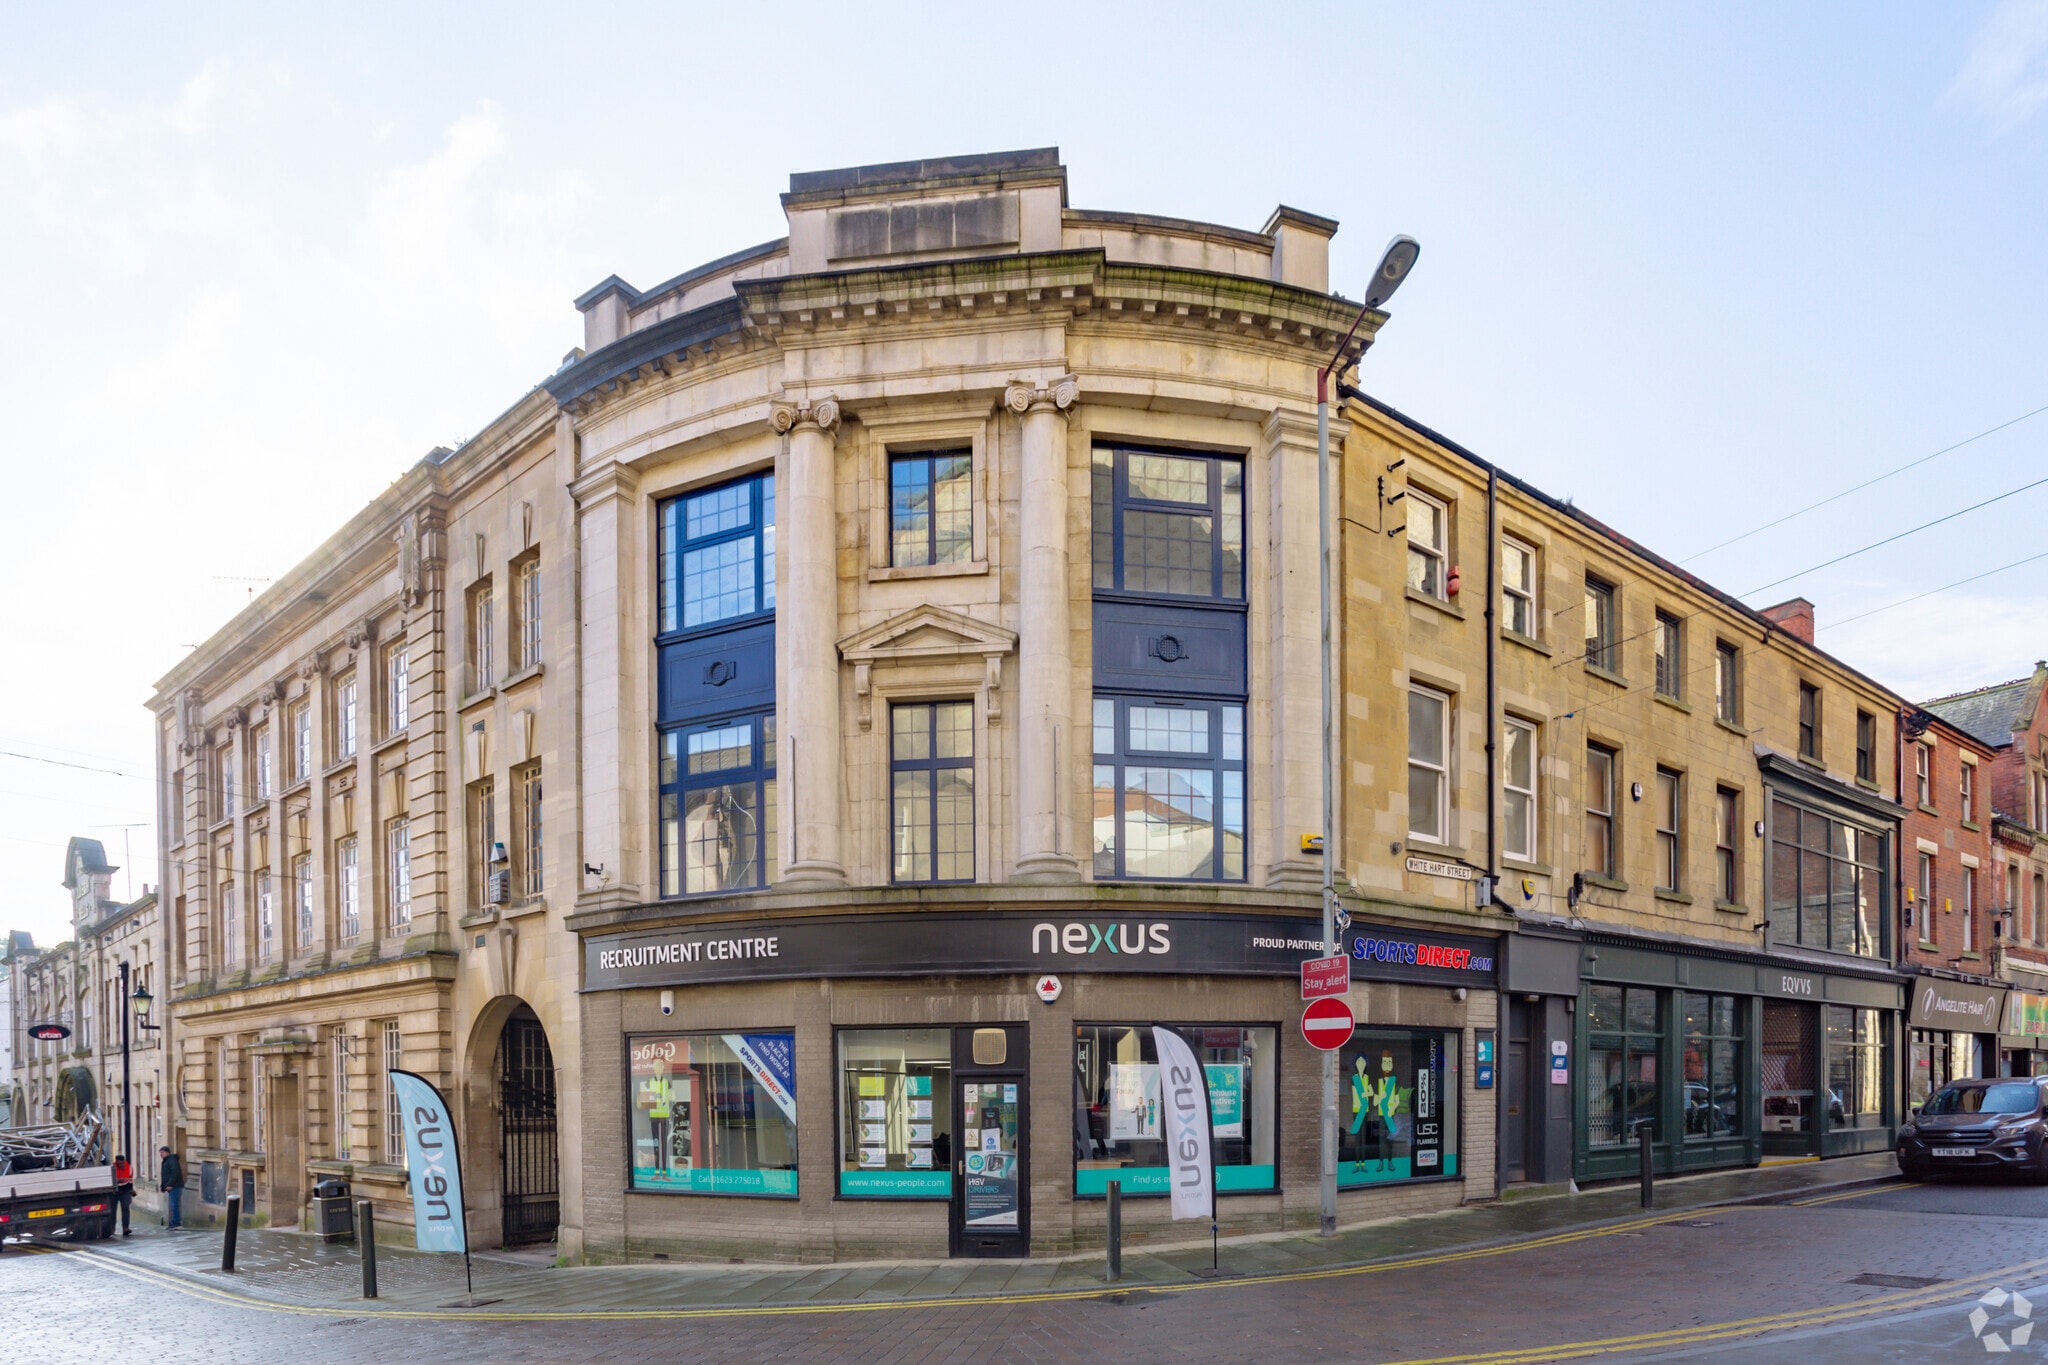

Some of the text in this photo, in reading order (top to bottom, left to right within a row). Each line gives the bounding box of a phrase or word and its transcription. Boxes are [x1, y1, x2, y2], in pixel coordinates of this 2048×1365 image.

[1408, 860, 1470, 878] WHITE HART STREET
[1032, 922, 1171, 955] nexus
[1253, 937, 1342, 952] PROUD PARTNER OF
[600, 936, 779, 970] RECRUITMENT CENTRE
[1352, 937, 1493, 972] SPORTSDIRECT.COM
[1310, 958, 1340, 970] COVID 19
[1304, 973, 1348, 991] Stay alert
[1782, 976, 1811, 995] EQVVS
[1935, 996, 1985, 1015] ANGELITE HAIR
[38, 1031, 62, 1039] urban
[768, 1041, 790, 1067] PLACE TO
[778, 1041, 789, 1054] THE
[758, 1042, 790, 1078] FIND WORK AT
[712, 1175, 733, 1184] 01623
[734, 1176, 761, 1185] 275018
[848, 1179, 945, 1188] www.nexus-people.com
[968, 1178, 985, 1186] HGV
[1133, 1175, 1150, 1184] Find
[968, 1186, 1000, 1194] DRIVERS
